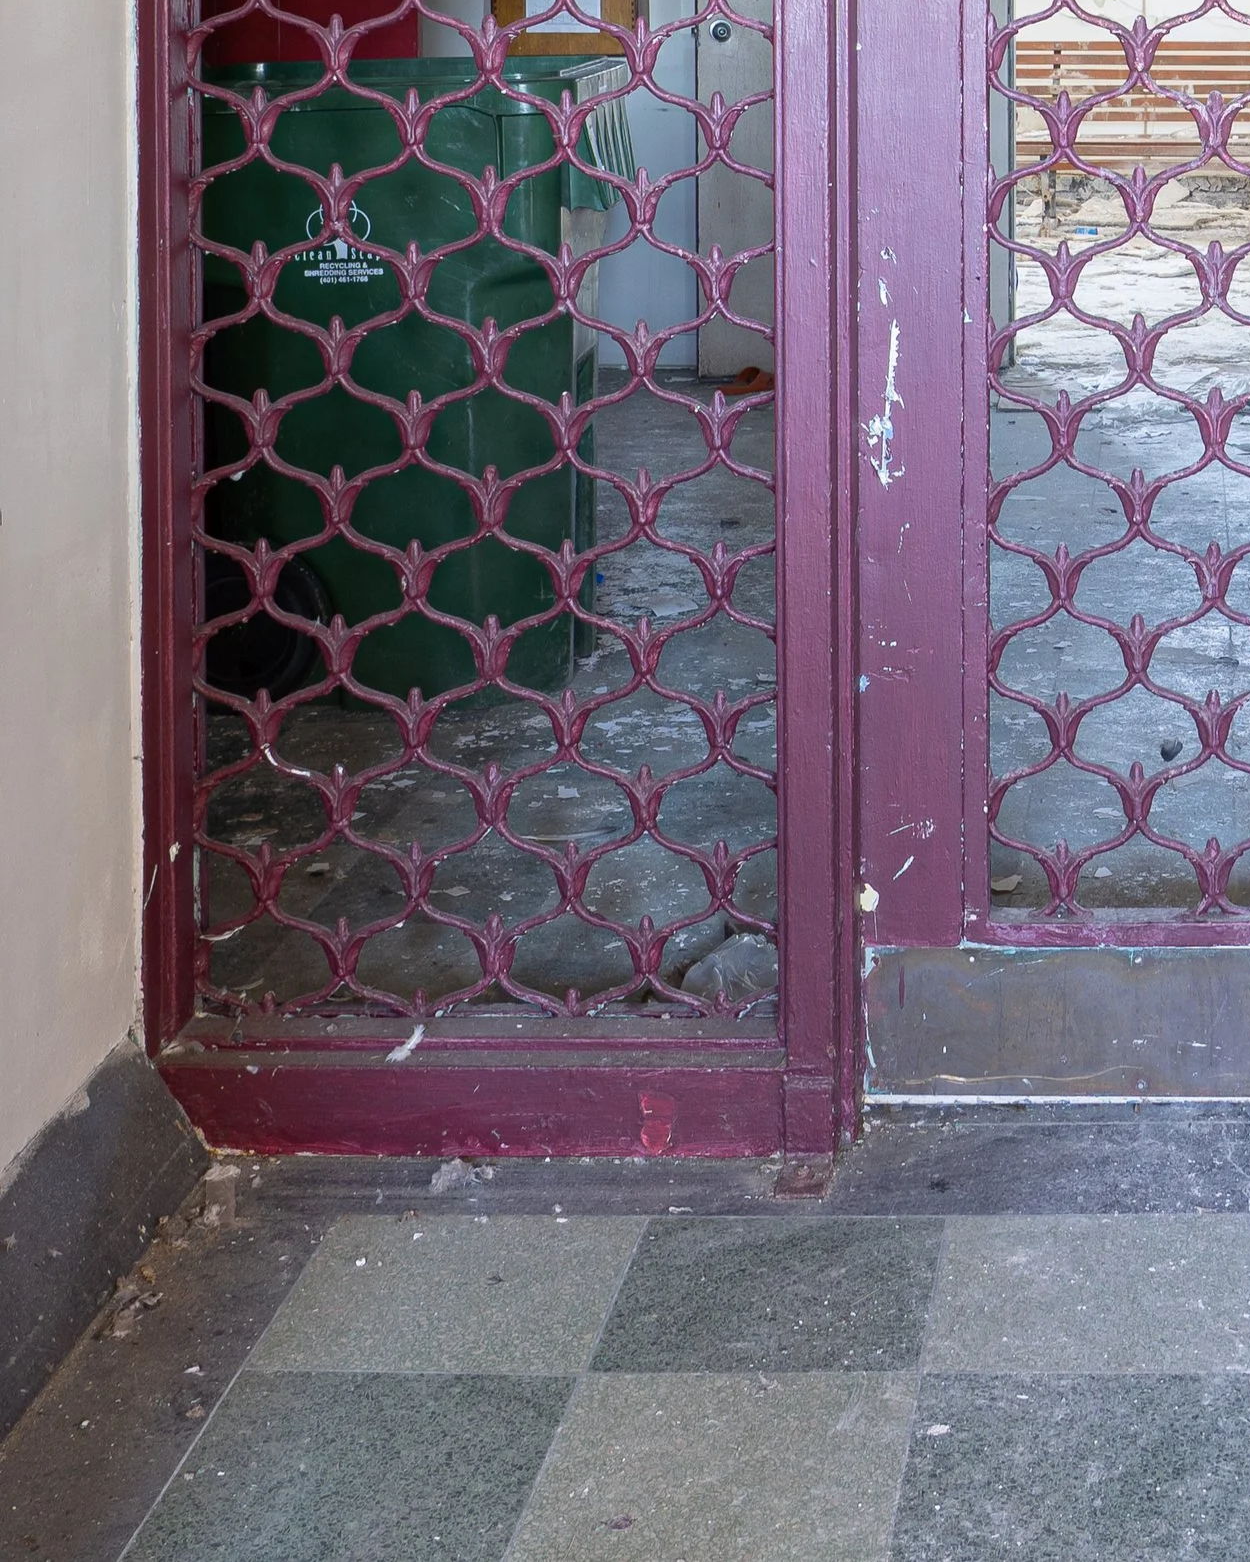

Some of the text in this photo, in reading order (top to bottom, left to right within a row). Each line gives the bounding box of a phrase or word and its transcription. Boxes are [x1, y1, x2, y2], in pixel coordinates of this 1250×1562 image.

[319, 262, 361, 270] RECYCLING
[304, 268, 384, 277] SHREDDING SERVICES
[320, 276, 337, 284] (401)
